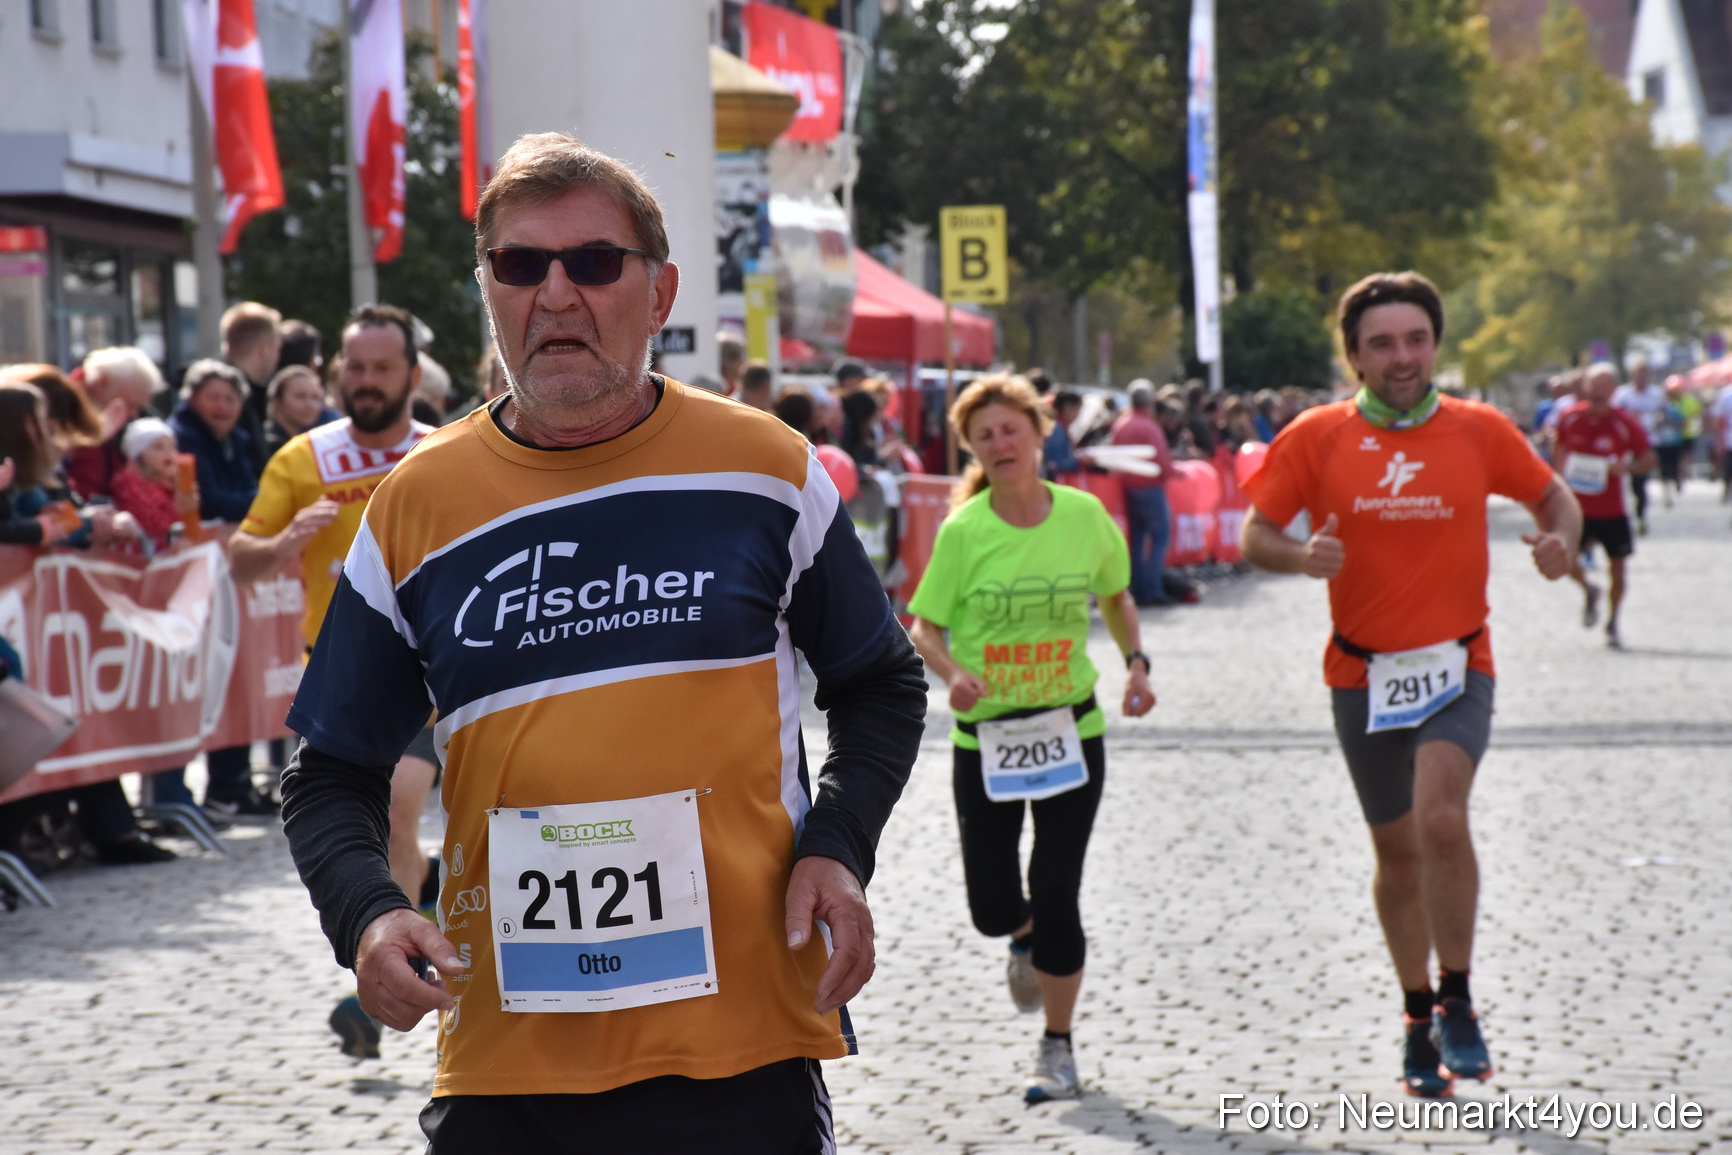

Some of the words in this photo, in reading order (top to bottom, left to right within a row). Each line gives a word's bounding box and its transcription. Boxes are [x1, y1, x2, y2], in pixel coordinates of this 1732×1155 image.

[960, 237, 989, 281] B
[1353, 496, 1442, 514] funrunners
[1379, 507, 1454, 520] neumarkt
[494, 564, 714, 631] Fischer
[516, 606, 702, 650] AUTOMOBILE
[984, 639, 1073, 665] MERZ
[983, 664, 1069, 684] PREMIUM
[1384, 670, 1449, 706] 2911
[996, 736, 1066, 769] 2203
[558, 820, 634, 842] BOCK
[583, 840, 590, 848] by
[610, 837, 637, 845] concepts
[518, 861, 664, 930] 2121
[446, 918, 469, 932] Audi
[503, 923, 511, 934] D
[578, 953, 622, 975] Otto
